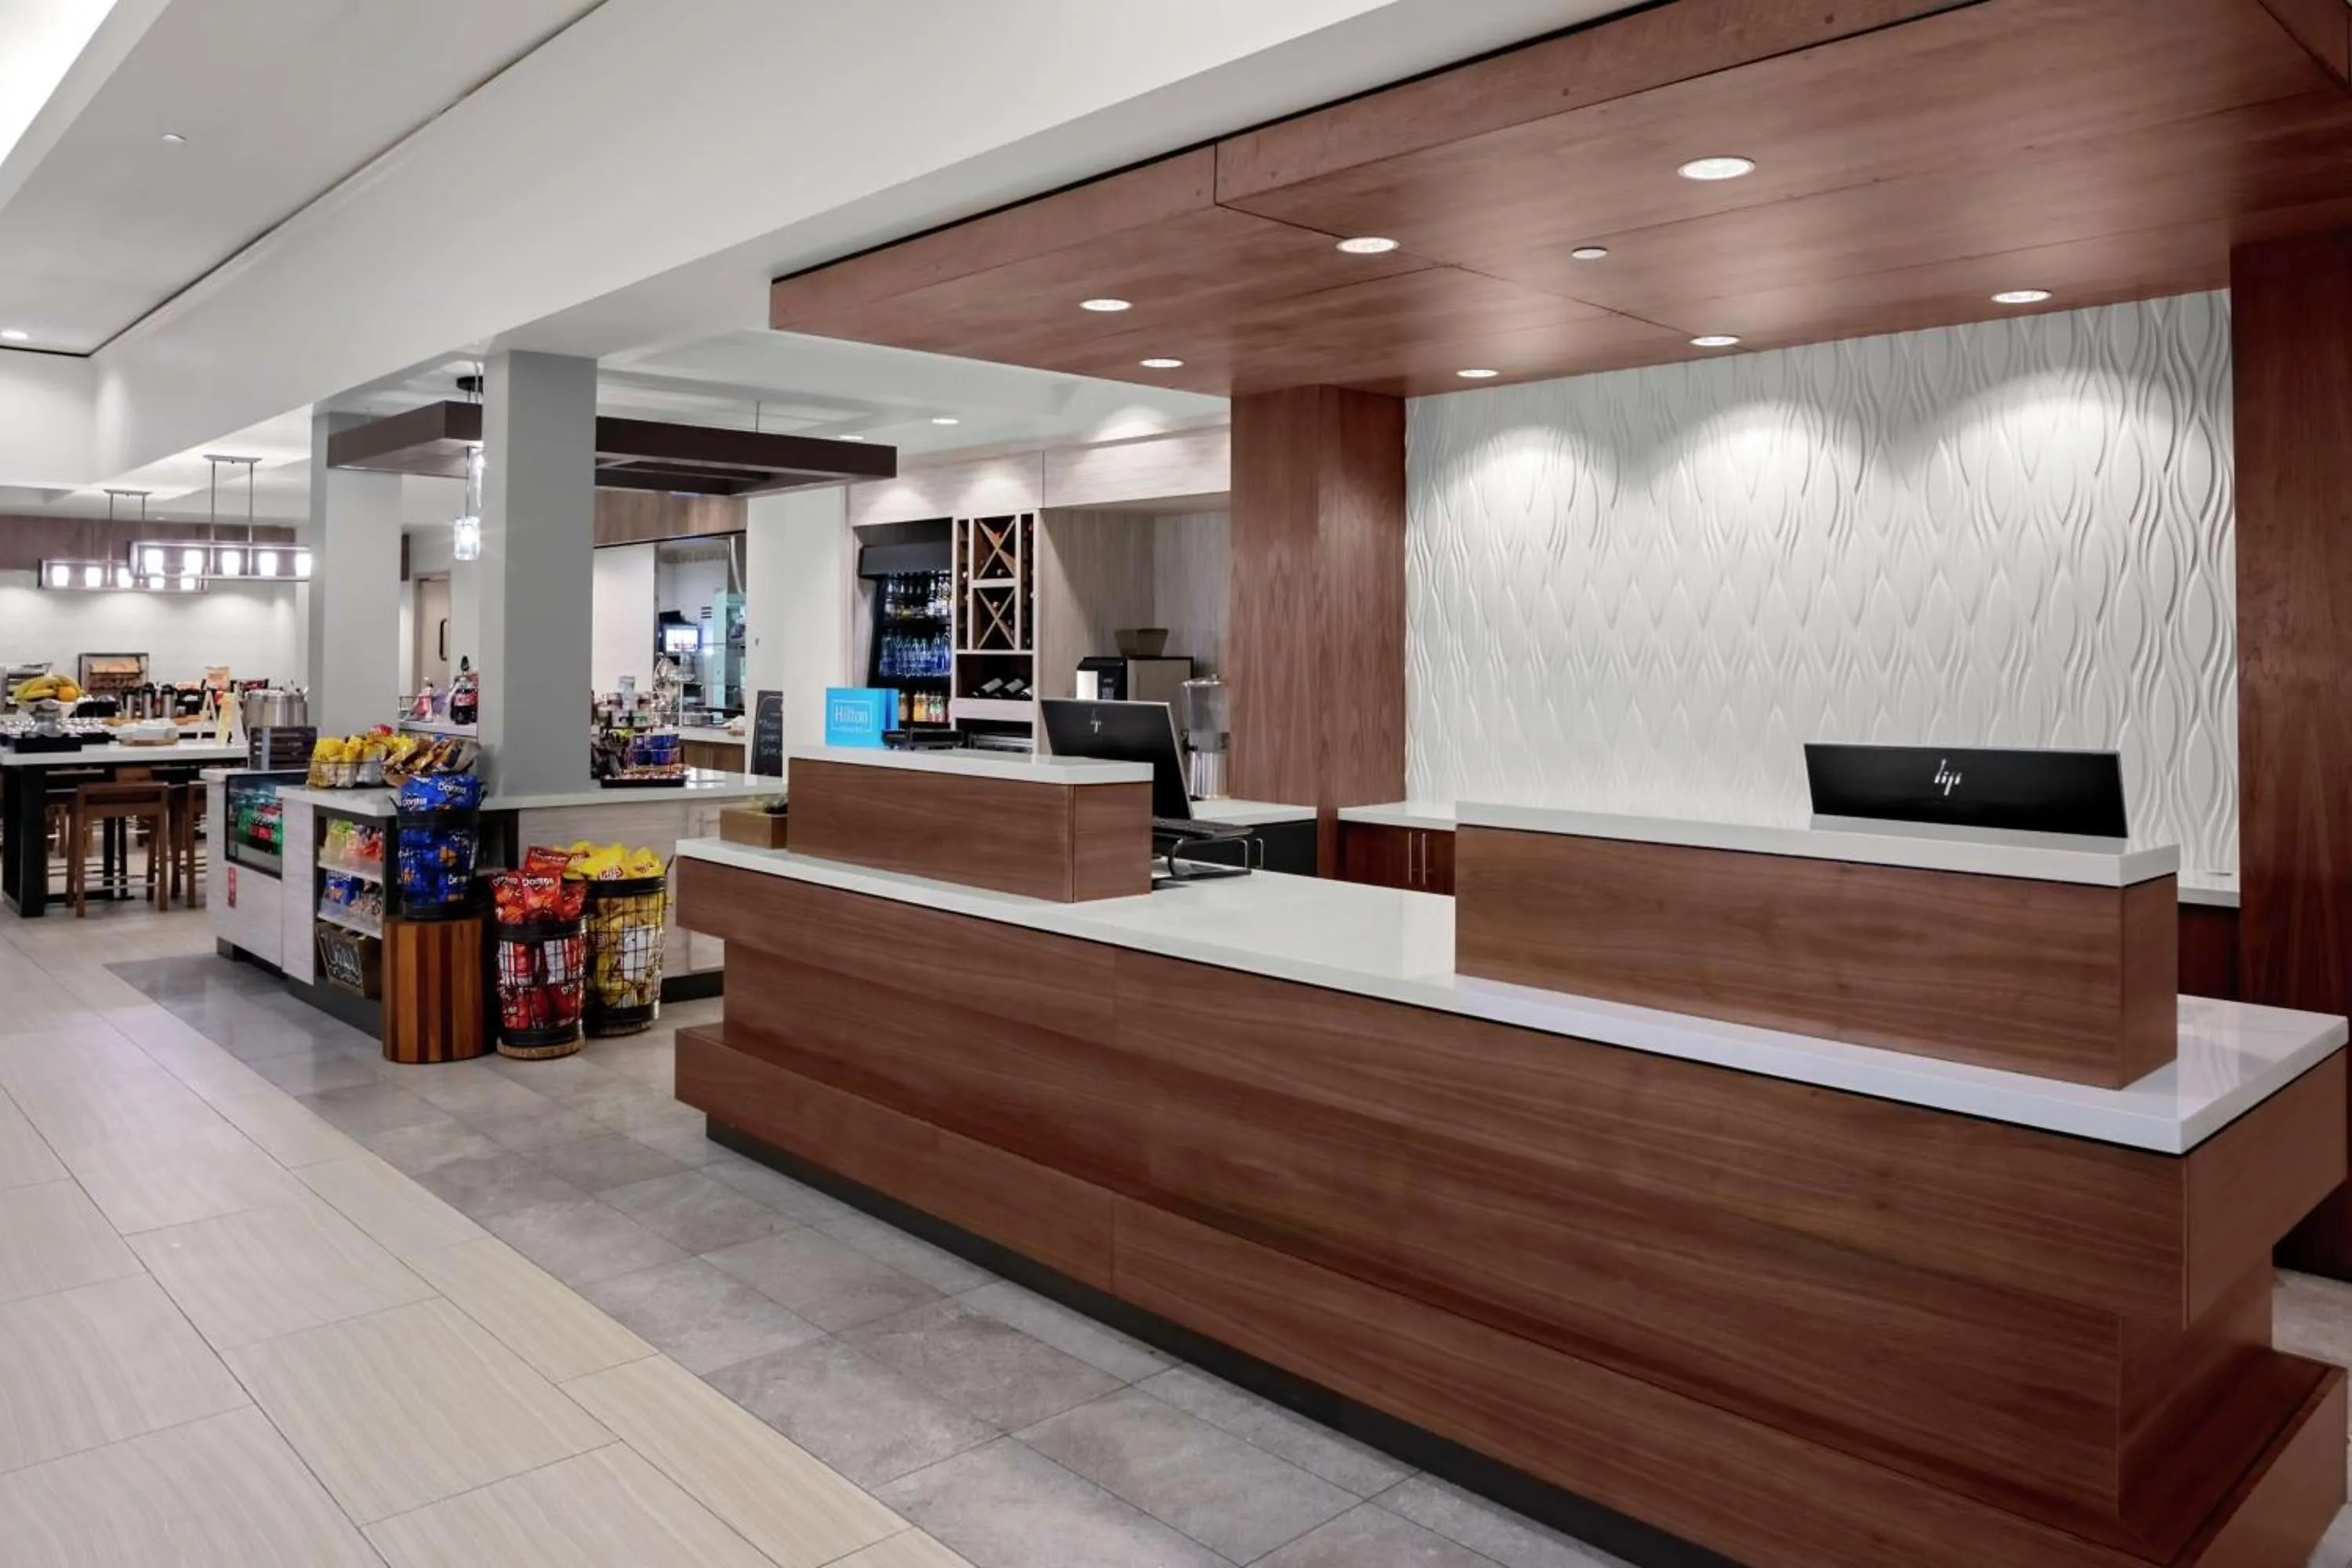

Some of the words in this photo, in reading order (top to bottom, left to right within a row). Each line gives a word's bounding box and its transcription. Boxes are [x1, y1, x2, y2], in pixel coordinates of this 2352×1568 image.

[835, 705, 868, 724] Hilton
[1934, 758, 1962, 797] hp
[521, 877, 554, 888] Doritos
